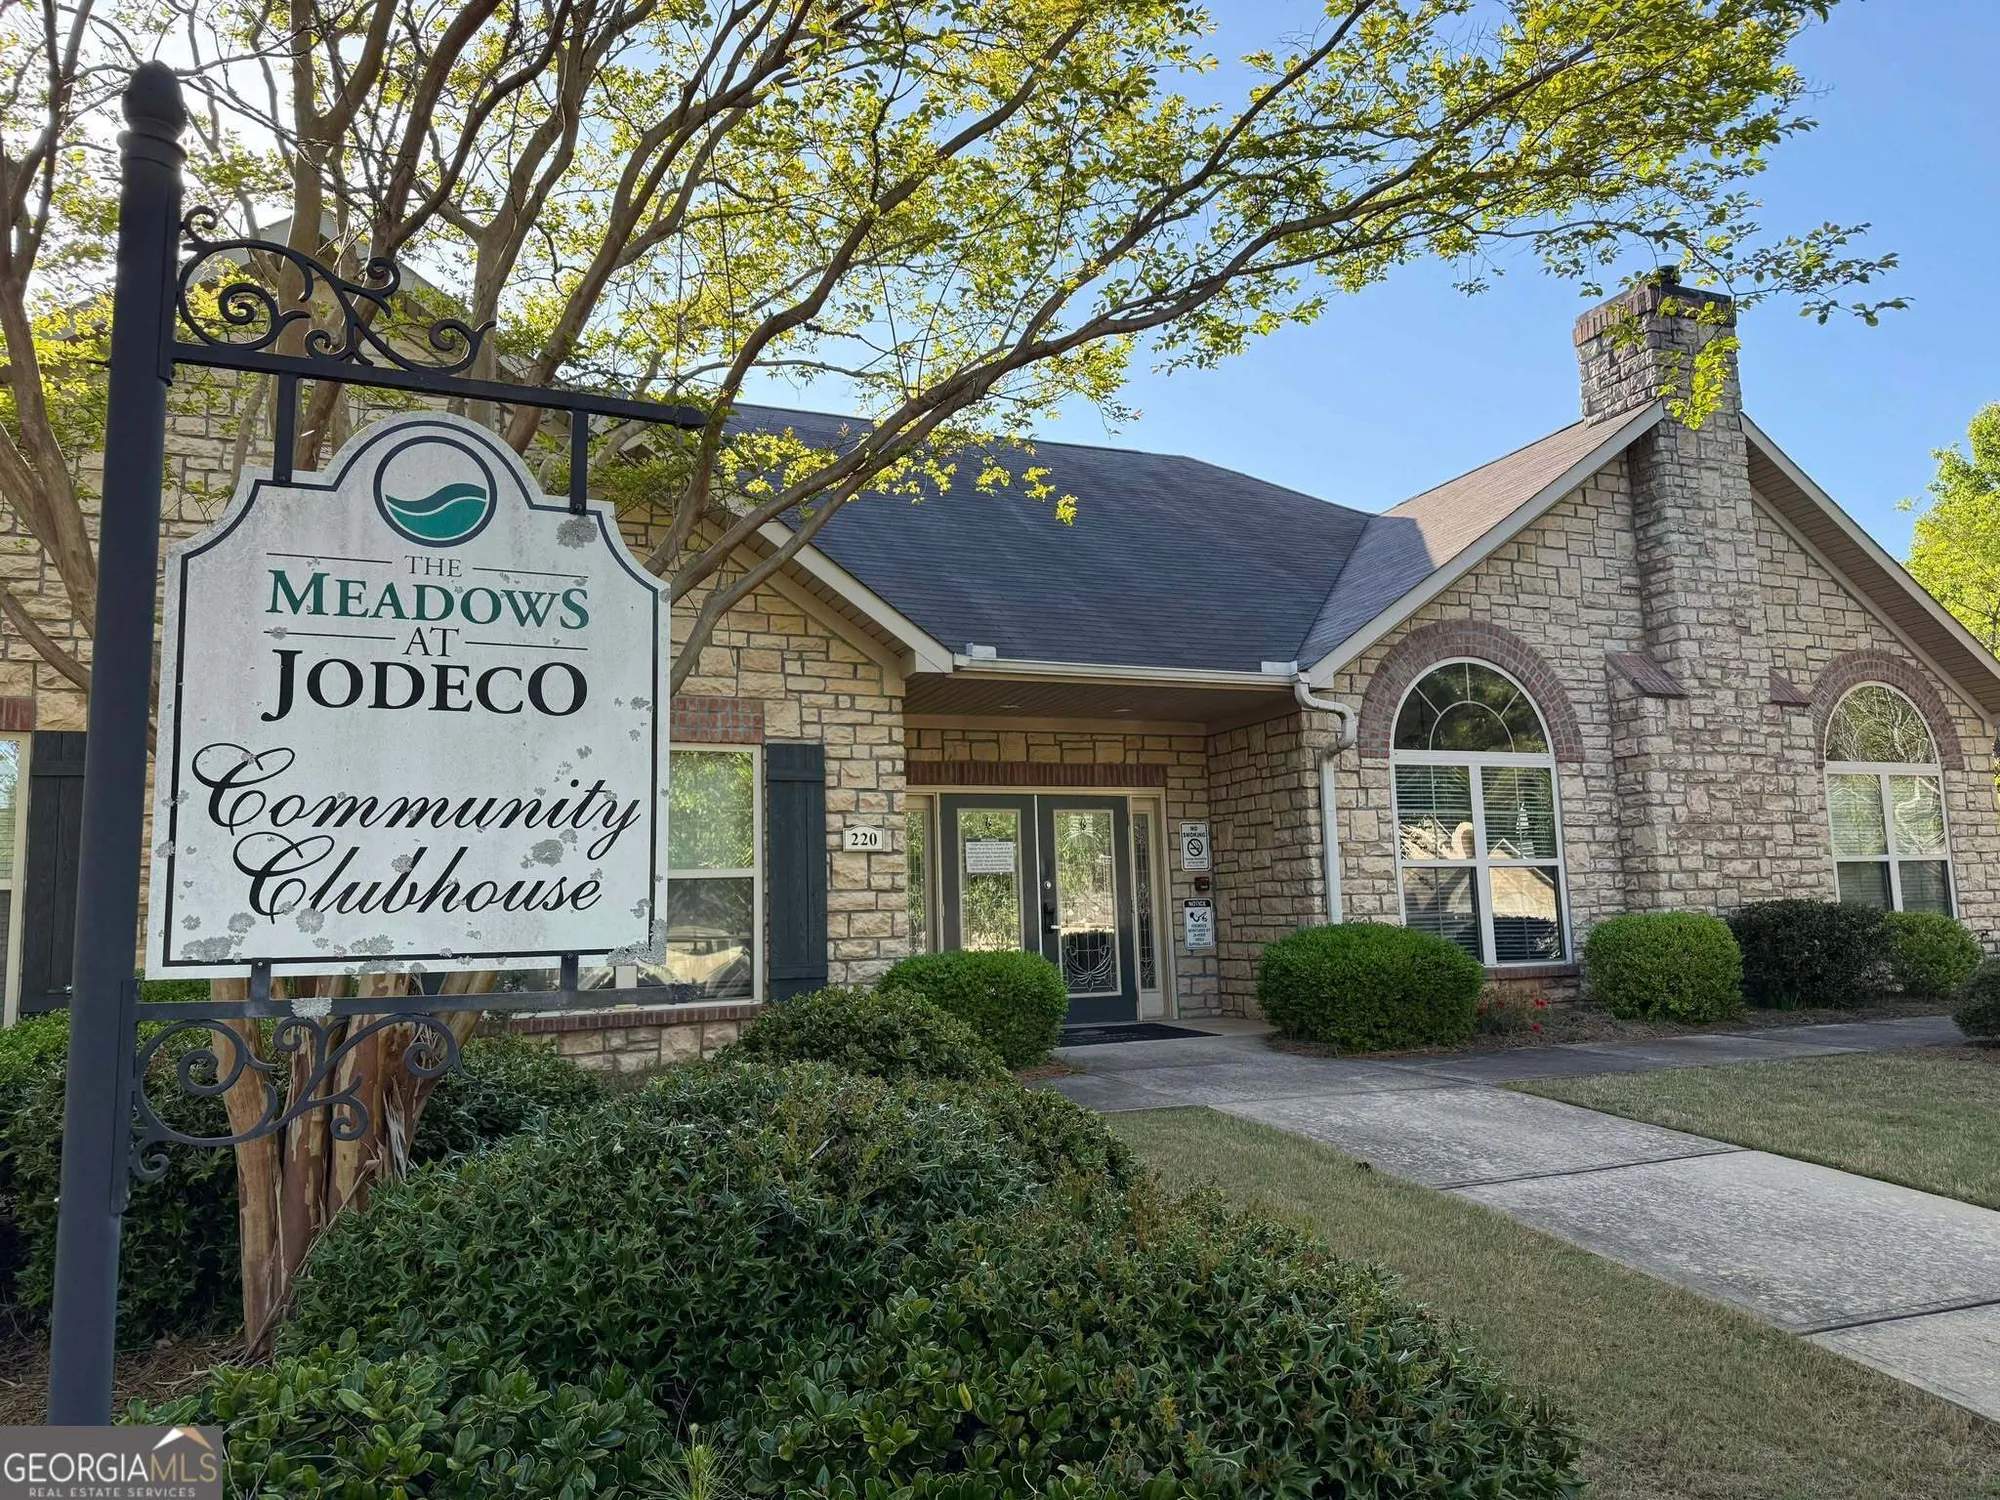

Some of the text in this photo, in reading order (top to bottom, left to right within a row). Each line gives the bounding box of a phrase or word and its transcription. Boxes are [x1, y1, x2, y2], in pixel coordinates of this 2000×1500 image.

[404, 555, 463, 578] THE
[265, 567, 590, 630] MEADOWS
[401, 626, 460, 658] AT
[260, 648, 588, 722] JODECO
[191, 742, 641, 861] Community
[851, 832, 877, 846] 220
[232, 831, 602, 925] Clubhouse
